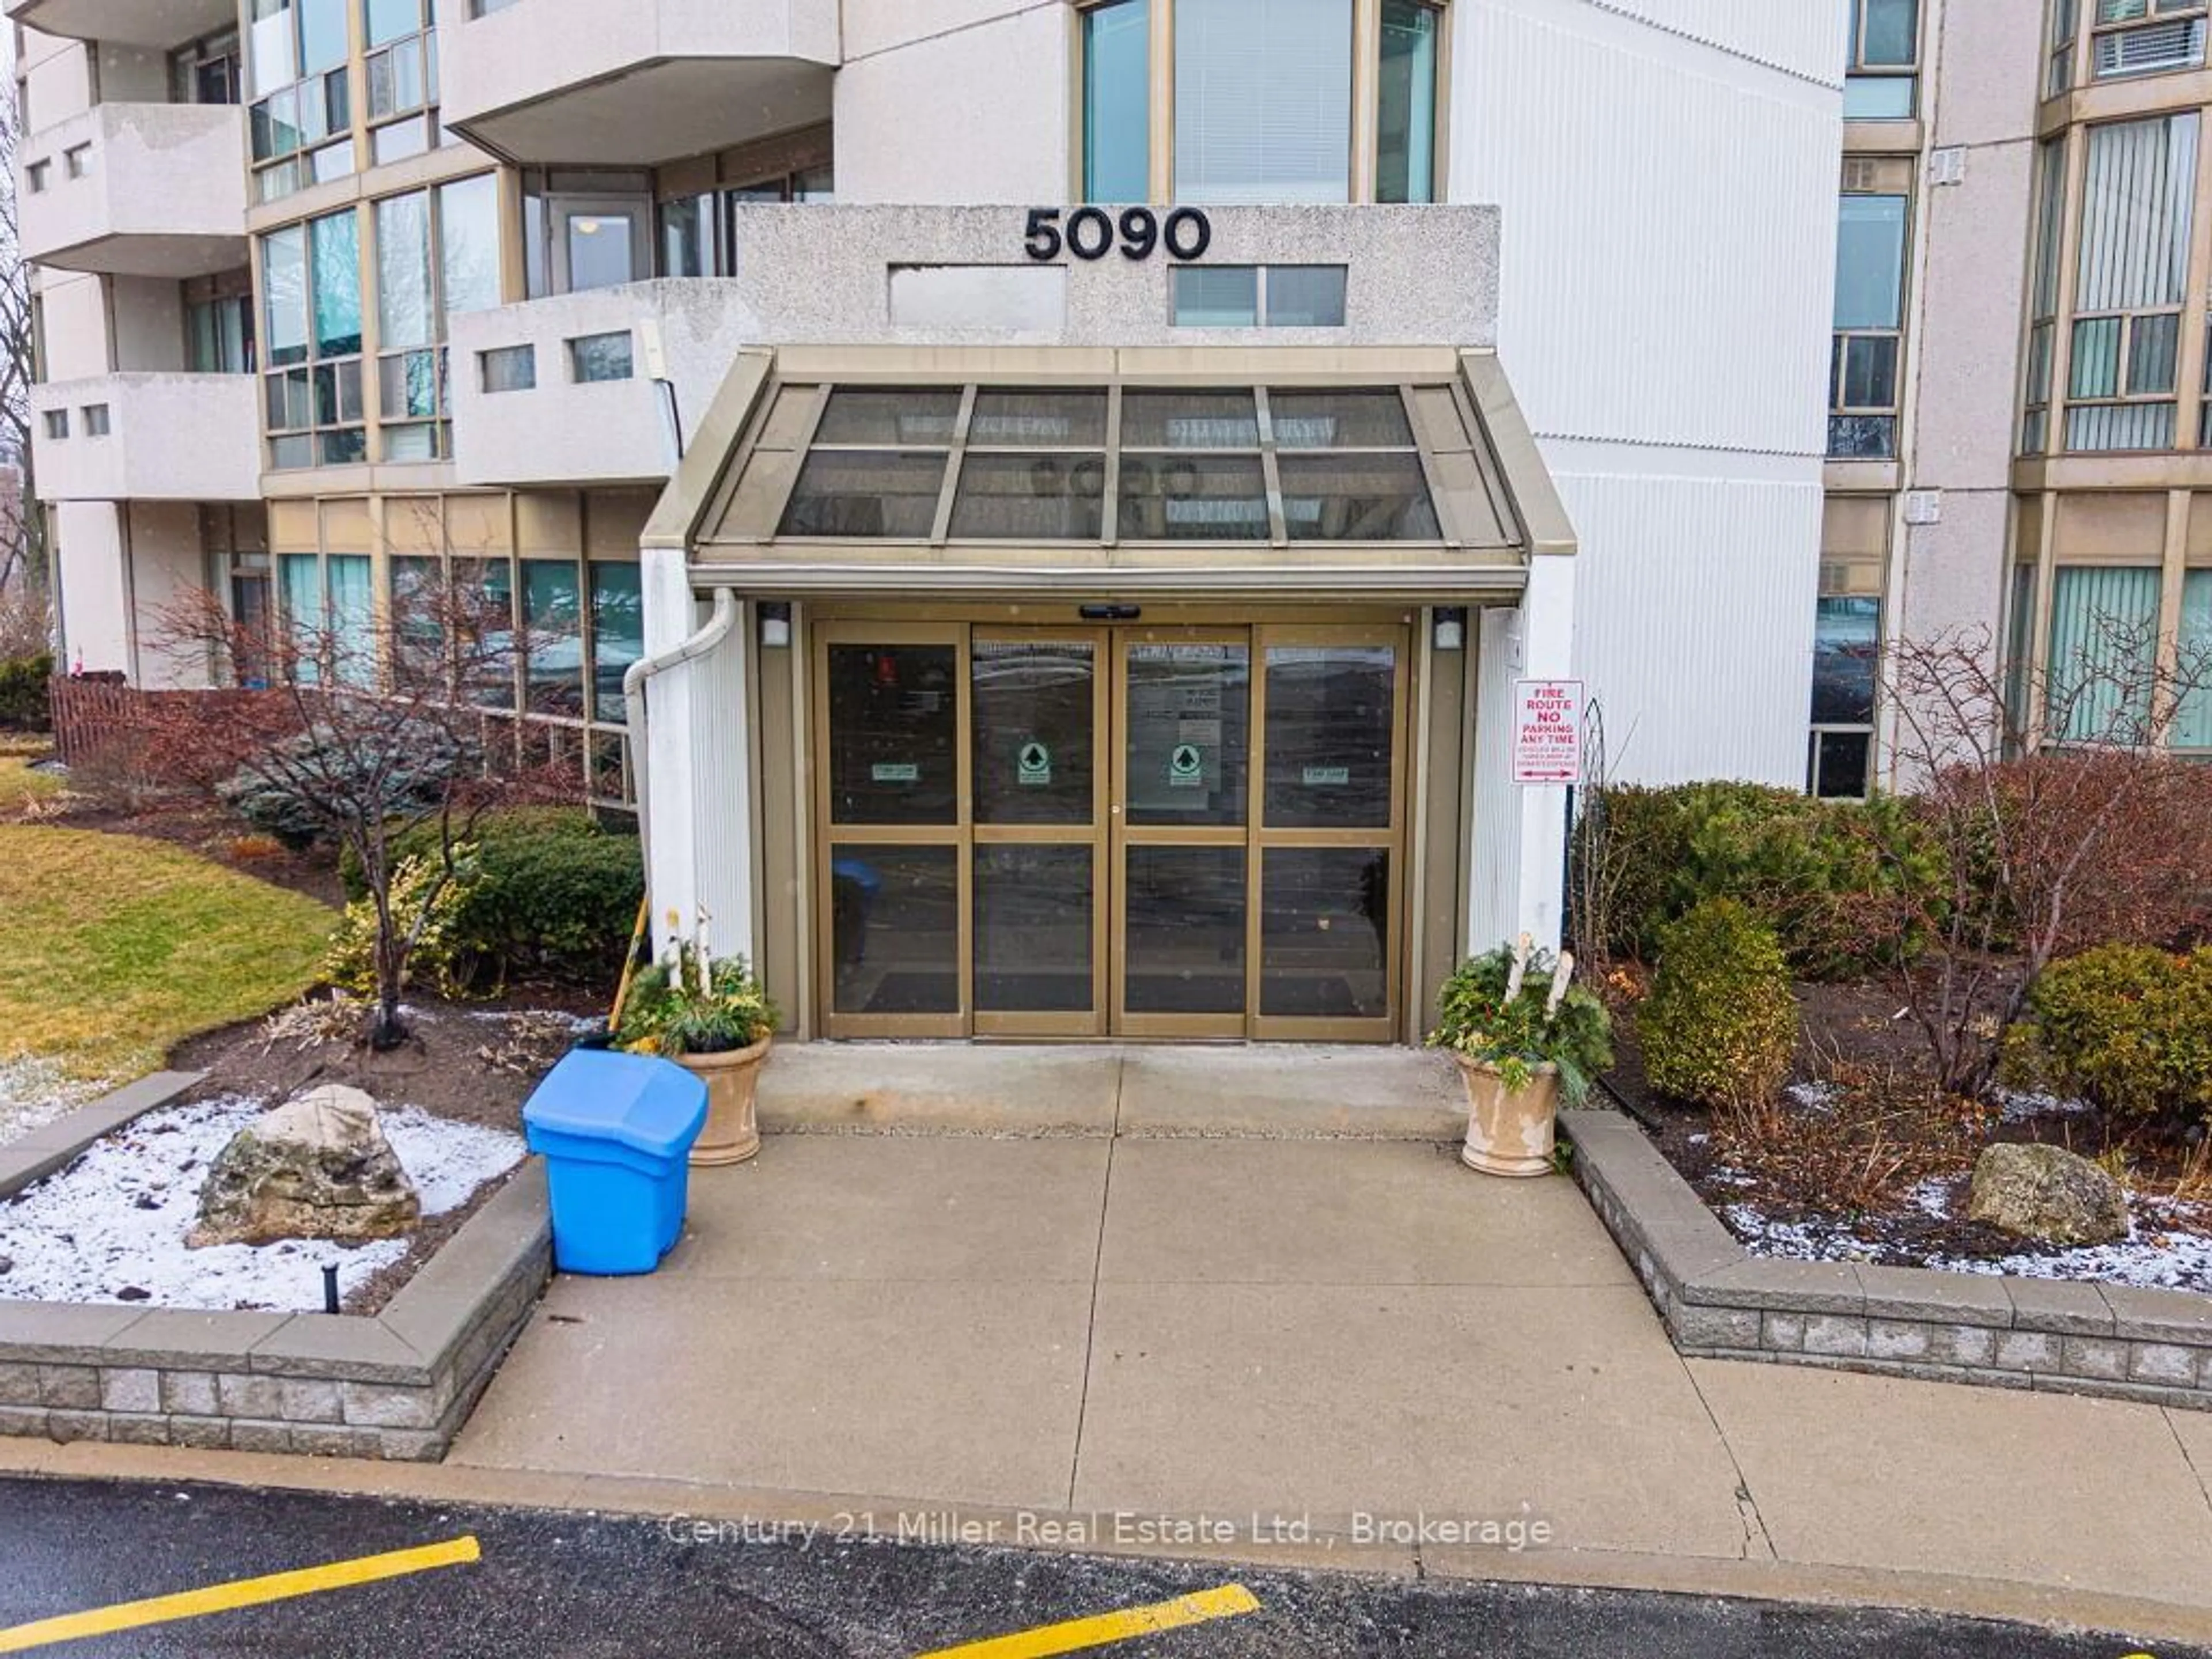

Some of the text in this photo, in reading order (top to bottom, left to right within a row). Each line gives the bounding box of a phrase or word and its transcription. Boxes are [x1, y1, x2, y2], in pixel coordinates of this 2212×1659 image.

[1025, 207, 1210, 260] 5090
[1535, 689, 1565, 698] FIRE
[1527, 700, 1571, 710] ROUTE
[1537, 711, 1560, 722] NO
[1522, 724, 1574, 733] PARKING
[1521, 734, 1574, 744] ANY TIME
